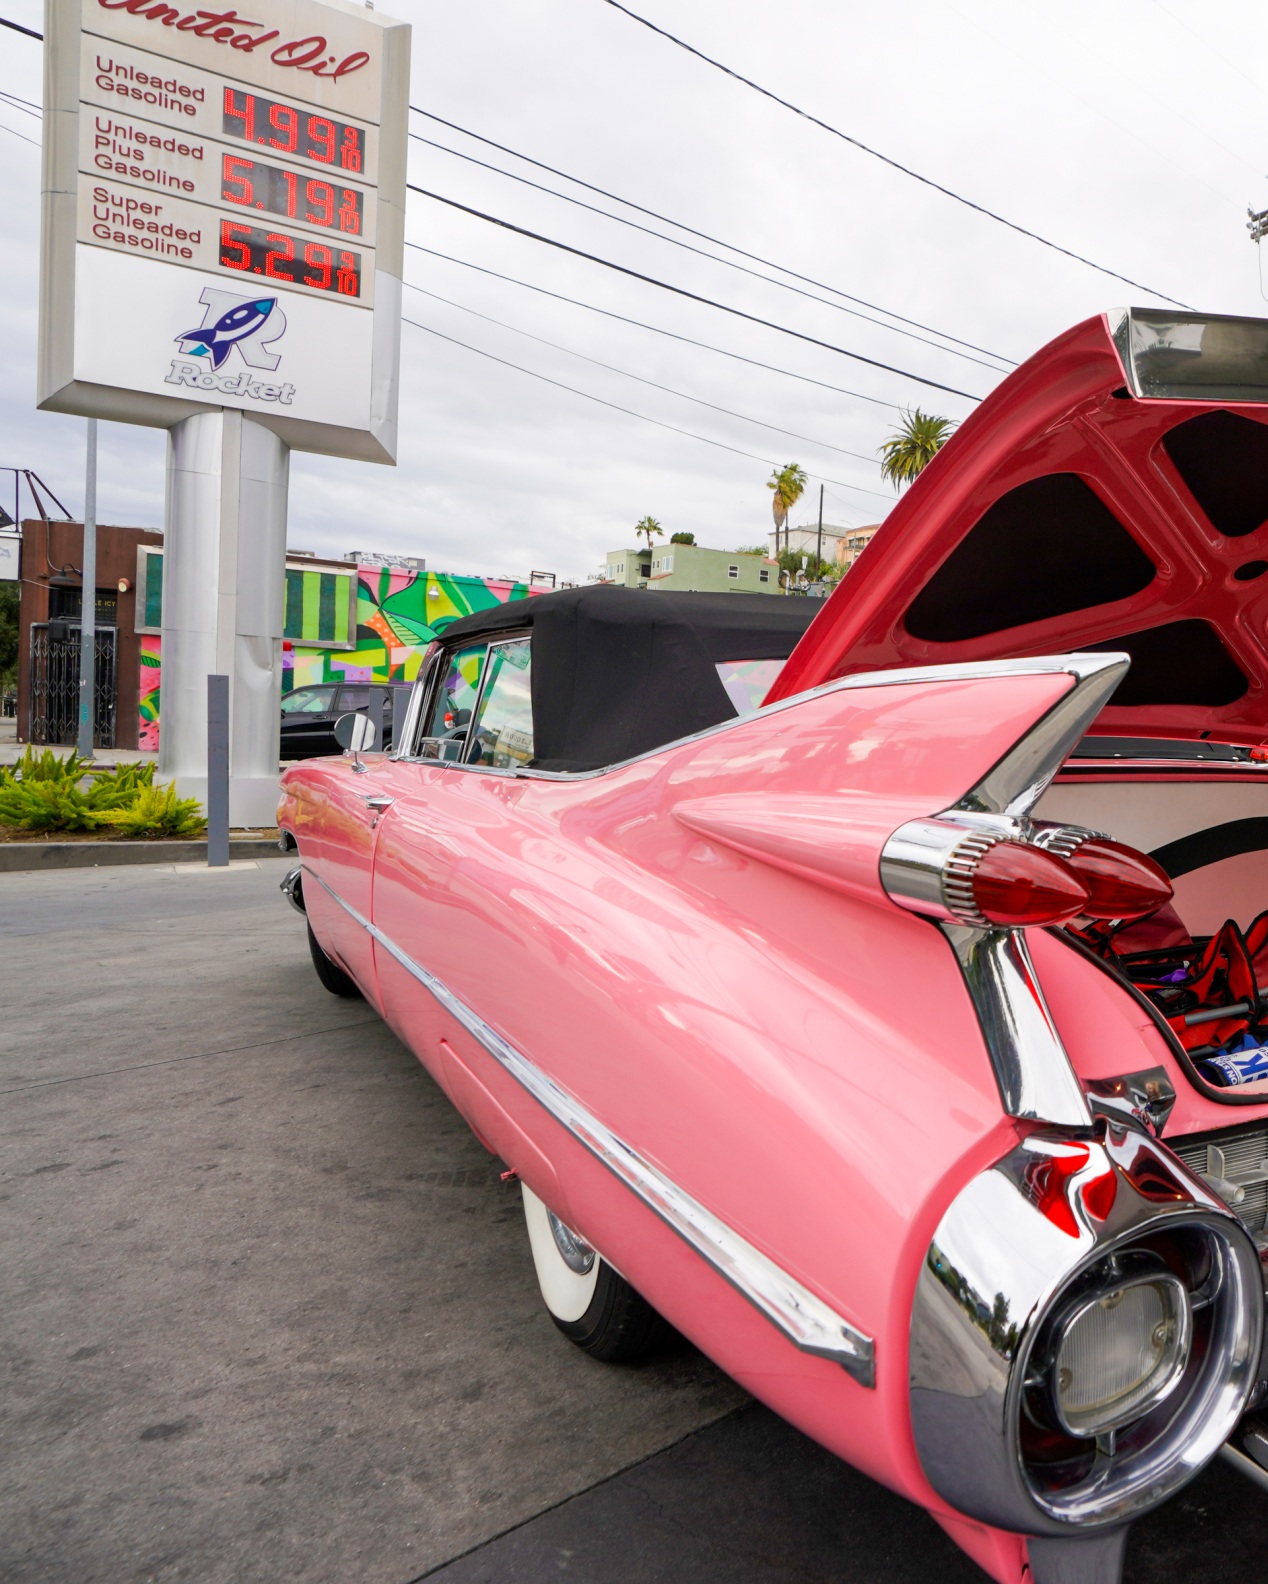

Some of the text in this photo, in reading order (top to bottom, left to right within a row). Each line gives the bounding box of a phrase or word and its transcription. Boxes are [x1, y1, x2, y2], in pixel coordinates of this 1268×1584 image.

[96, 55, 205, 102] Unleaded
[270, 36, 370, 84] Oil
[95, 74, 197, 116] Gasoline
[95, 116, 204, 160] Unleaded
[95, 134, 145, 161] Plus
[224, 88, 336, 164] 4.99
[94, 153, 195, 192] Gasoline
[223, 154, 334, 227] 5.19
[93, 187, 163, 216] Super
[92, 223, 193, 259] Gasoline
[93, 204, 201, 244] Unleaded
[221, 220, 332, 289] 5.29
[164, 359, 296, 405] Rocket
